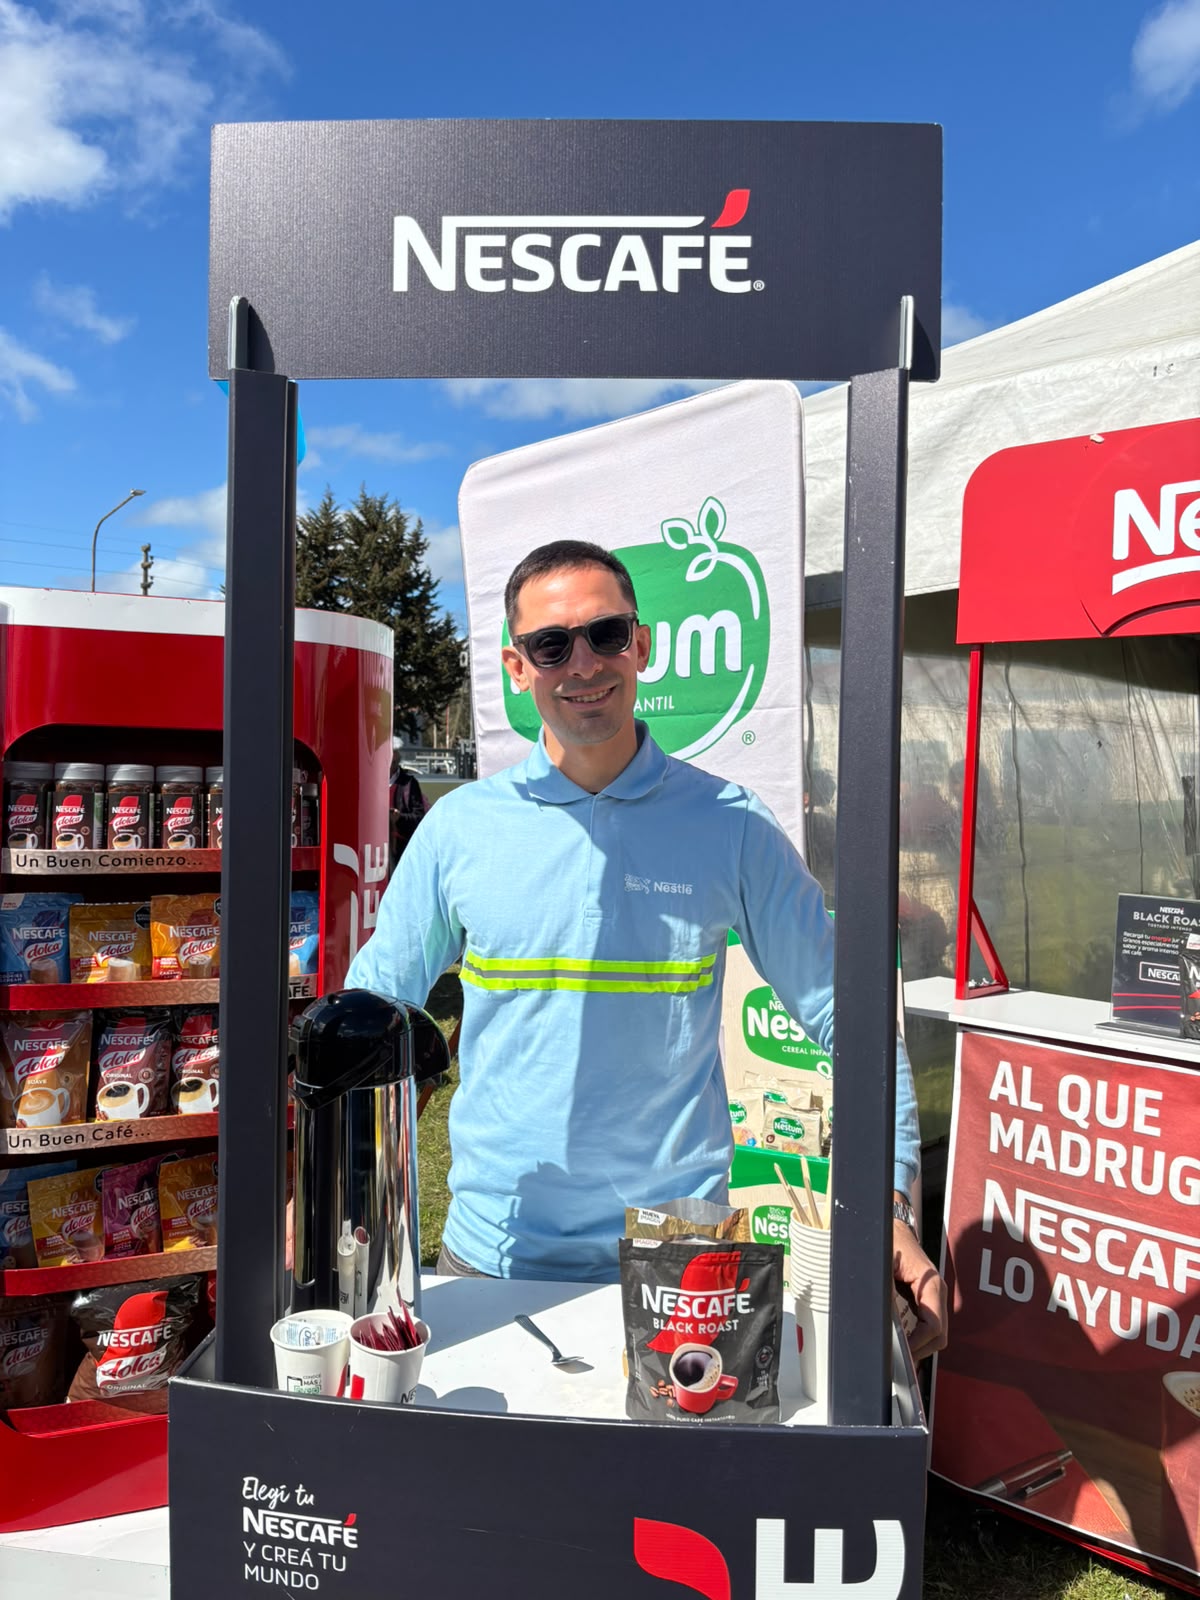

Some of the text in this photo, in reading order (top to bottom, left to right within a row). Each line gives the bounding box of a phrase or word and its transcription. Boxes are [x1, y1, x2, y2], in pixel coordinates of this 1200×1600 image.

[393, 189, 753, 293] NESCAFÉ
[16, 854, 203, 868] Un Buen Comienzo...
[1133, 911, 1170, 924] BLACK
[27, 943, 60, 959] dolca
[100, 944, 131, 957] dolca
[182, 940, 214, 957] dolca
[747, 1006, 816, 1045] Nes
[102, 1051, 141, 1069] dolca
[782, 1046, 808, 1055] CEREAL
[18, 1056, 59, 1076] dolca
[989, 1060, 1163, 1137] AL QUE
[9, 1135, 32, 1148] Un
[39, 1133, 85, 1147] Buen
[989, 1111, 1200, 1206] MADRUG
[64, 1213, 94, 1234] dolca
[754, 1216, 790, 1239] Nes
[978, 1248, 1035, 1303] LO
[641, 1278, 751, 1319] NESCAFÉ
[653, 1318, 739, 1335] BLACK ROAST
[6, 1344, 41, 1367] dolca
[101, 1353, 162, 1380] dolca
[107, 1383, 147, 1391] ORIGINAL
[242, 1476, 315, 1509] Elegí tu
[243, 1506, 358, 1549] NESCAFÉ
[243, 1541, 347, 1572] Y CREÁ TU
[243, 1563, 320, 1591] MUNDO
